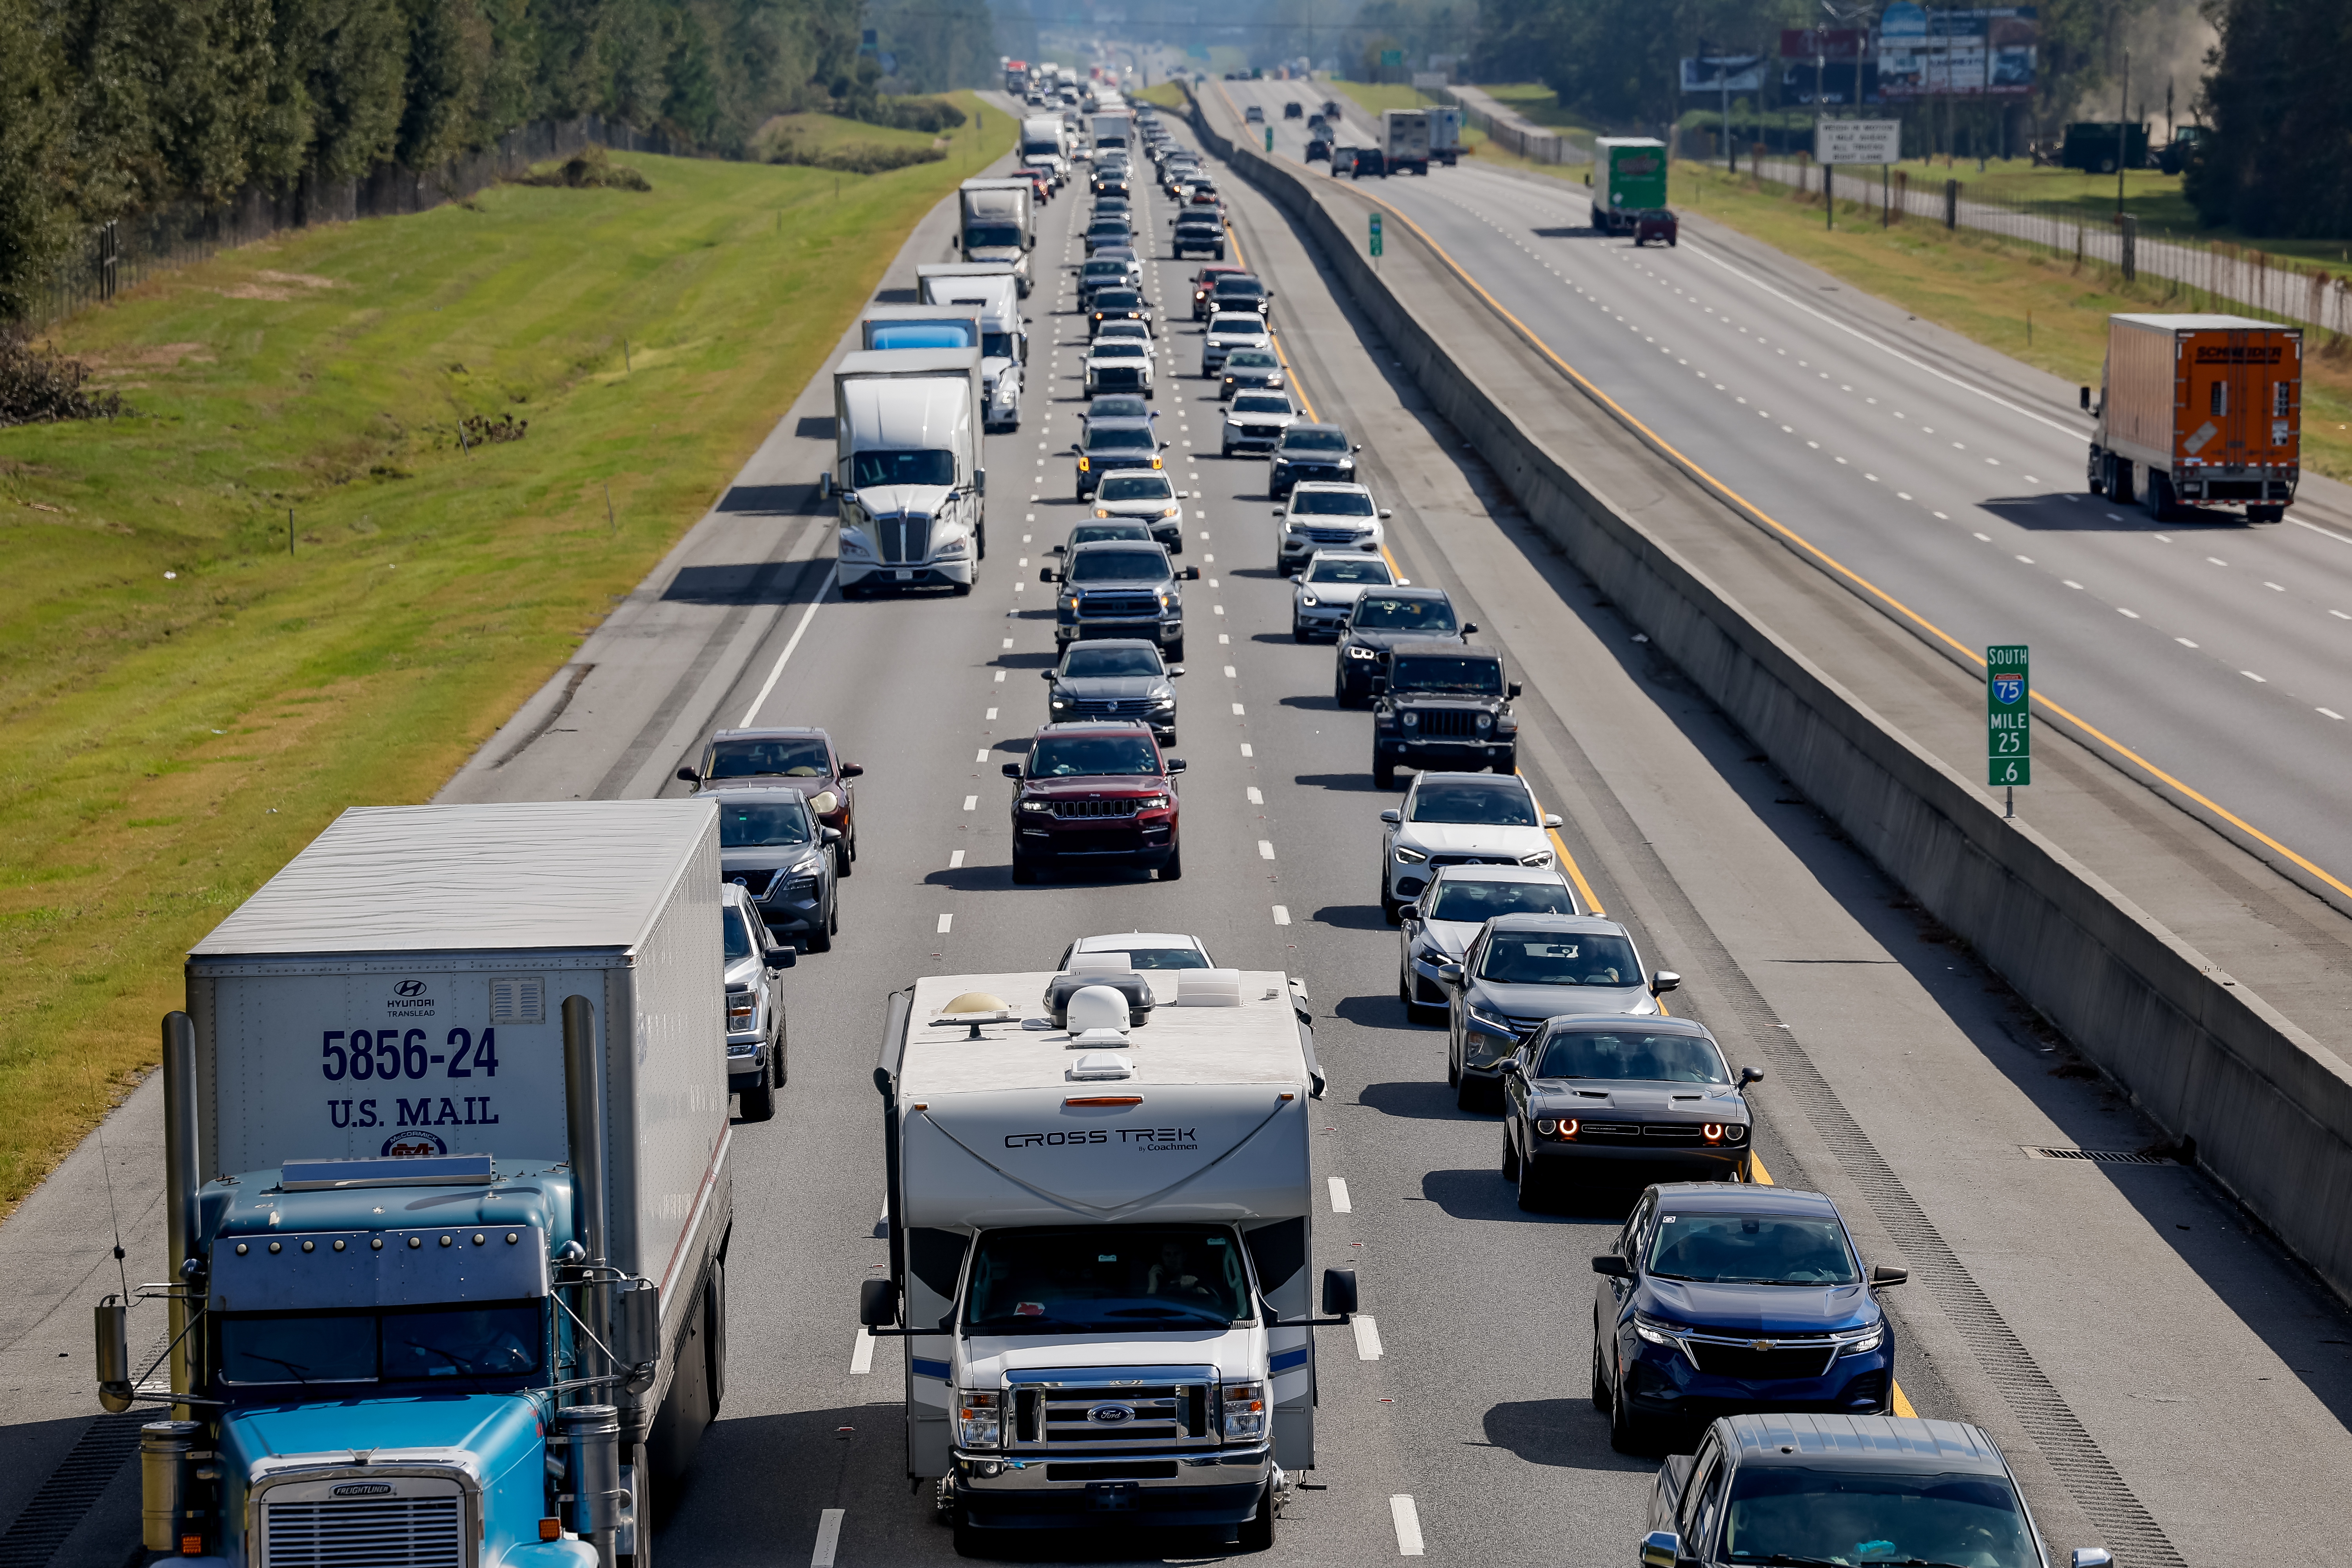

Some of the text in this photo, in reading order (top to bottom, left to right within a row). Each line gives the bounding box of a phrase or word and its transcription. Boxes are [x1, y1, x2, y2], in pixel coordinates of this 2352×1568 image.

[2197, 346, 2282, 358] SCHNEIDER
[1989, 648, 2027, 665] SOUTH
[1997, 681, 2019, 699] 75
[1991, 713, 2027, 729] MILE
[1999, 732, 2020, 752] 25
[2000, 762, 2018, 782] .6
[387, 999, 434, 1007] HYUNDAI
[322, 1027, 499, 1081] 5856-24
[327, 1096, 499, 1128] U.S. MAIL
[390, 1131, 438, 1143] McCORMICK
[1004, 1127, 1197, 1148] CROSS TREK
[1101, 1410, 1121, 1419] Ford
[336, 1486, 388, 1495] FREIGHTLINER
